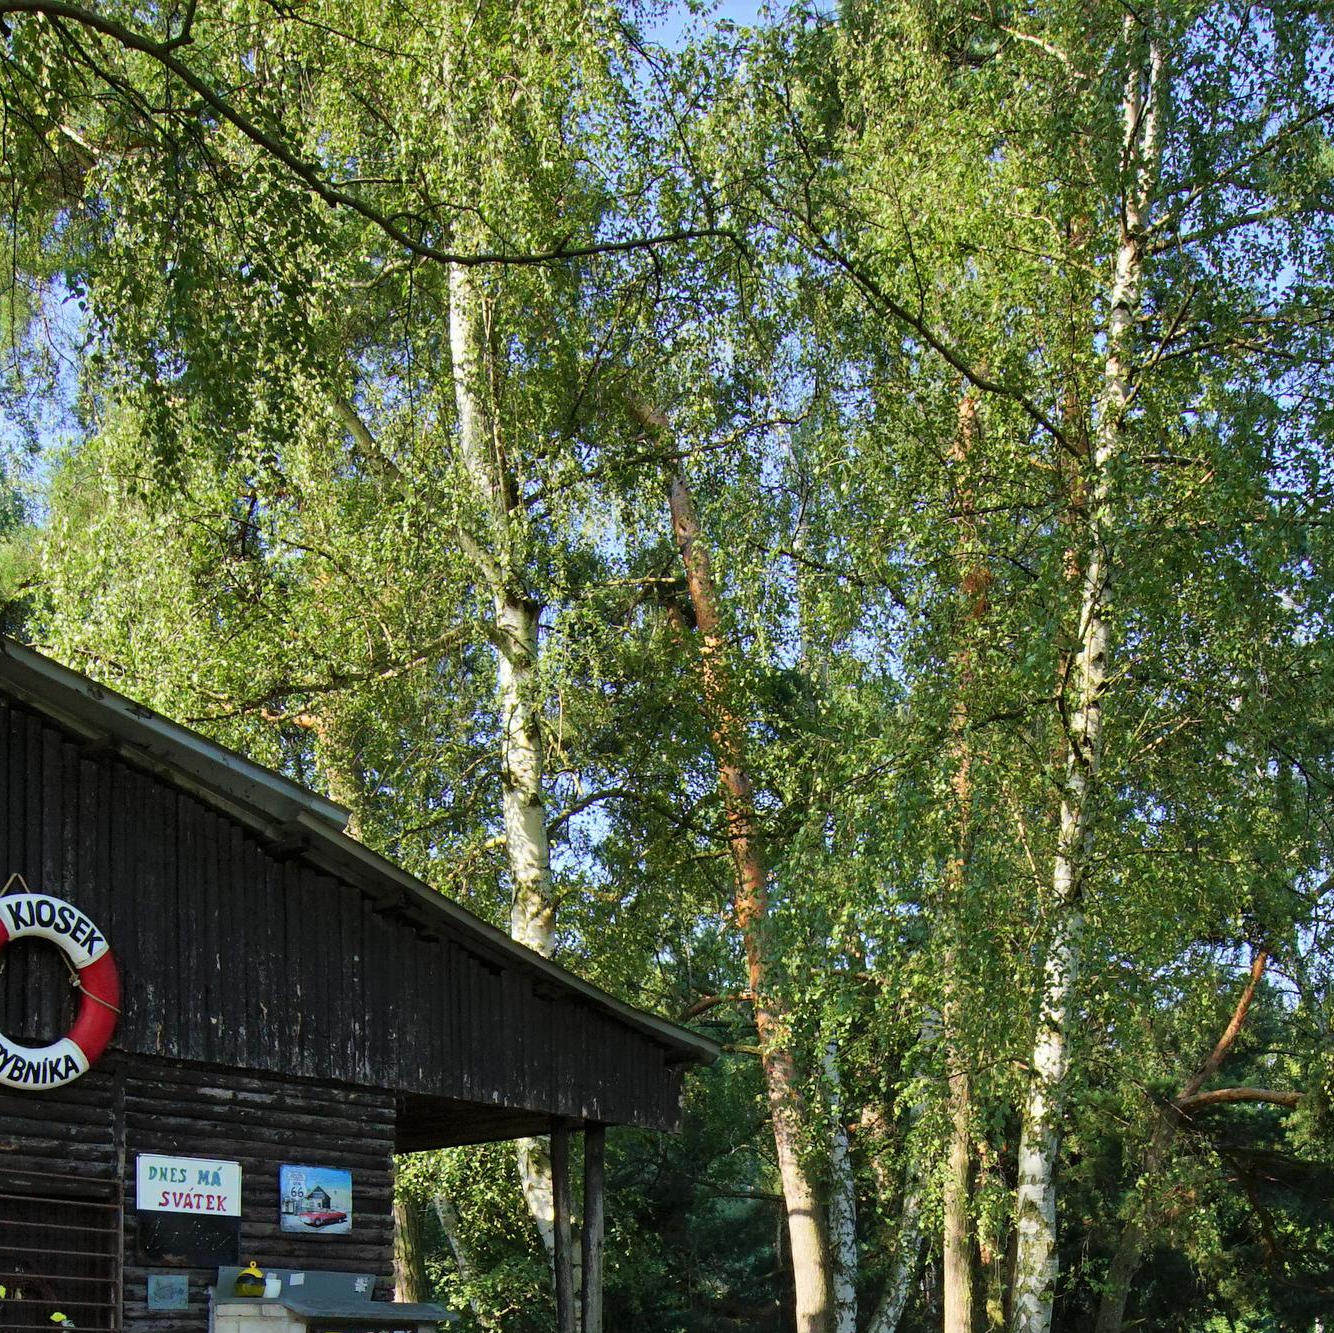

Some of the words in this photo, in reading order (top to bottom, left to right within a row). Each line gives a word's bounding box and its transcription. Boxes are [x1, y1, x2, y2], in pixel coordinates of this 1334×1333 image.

[7, 900, 104, 957] KIOSEK
[148, 1166, 187, 1183] DNES
[197, 1166, 222, 1187] MÁ
[158, 1187, 228, 1212] SVÁTEK
[290, 1186, 304, 1198] 66
